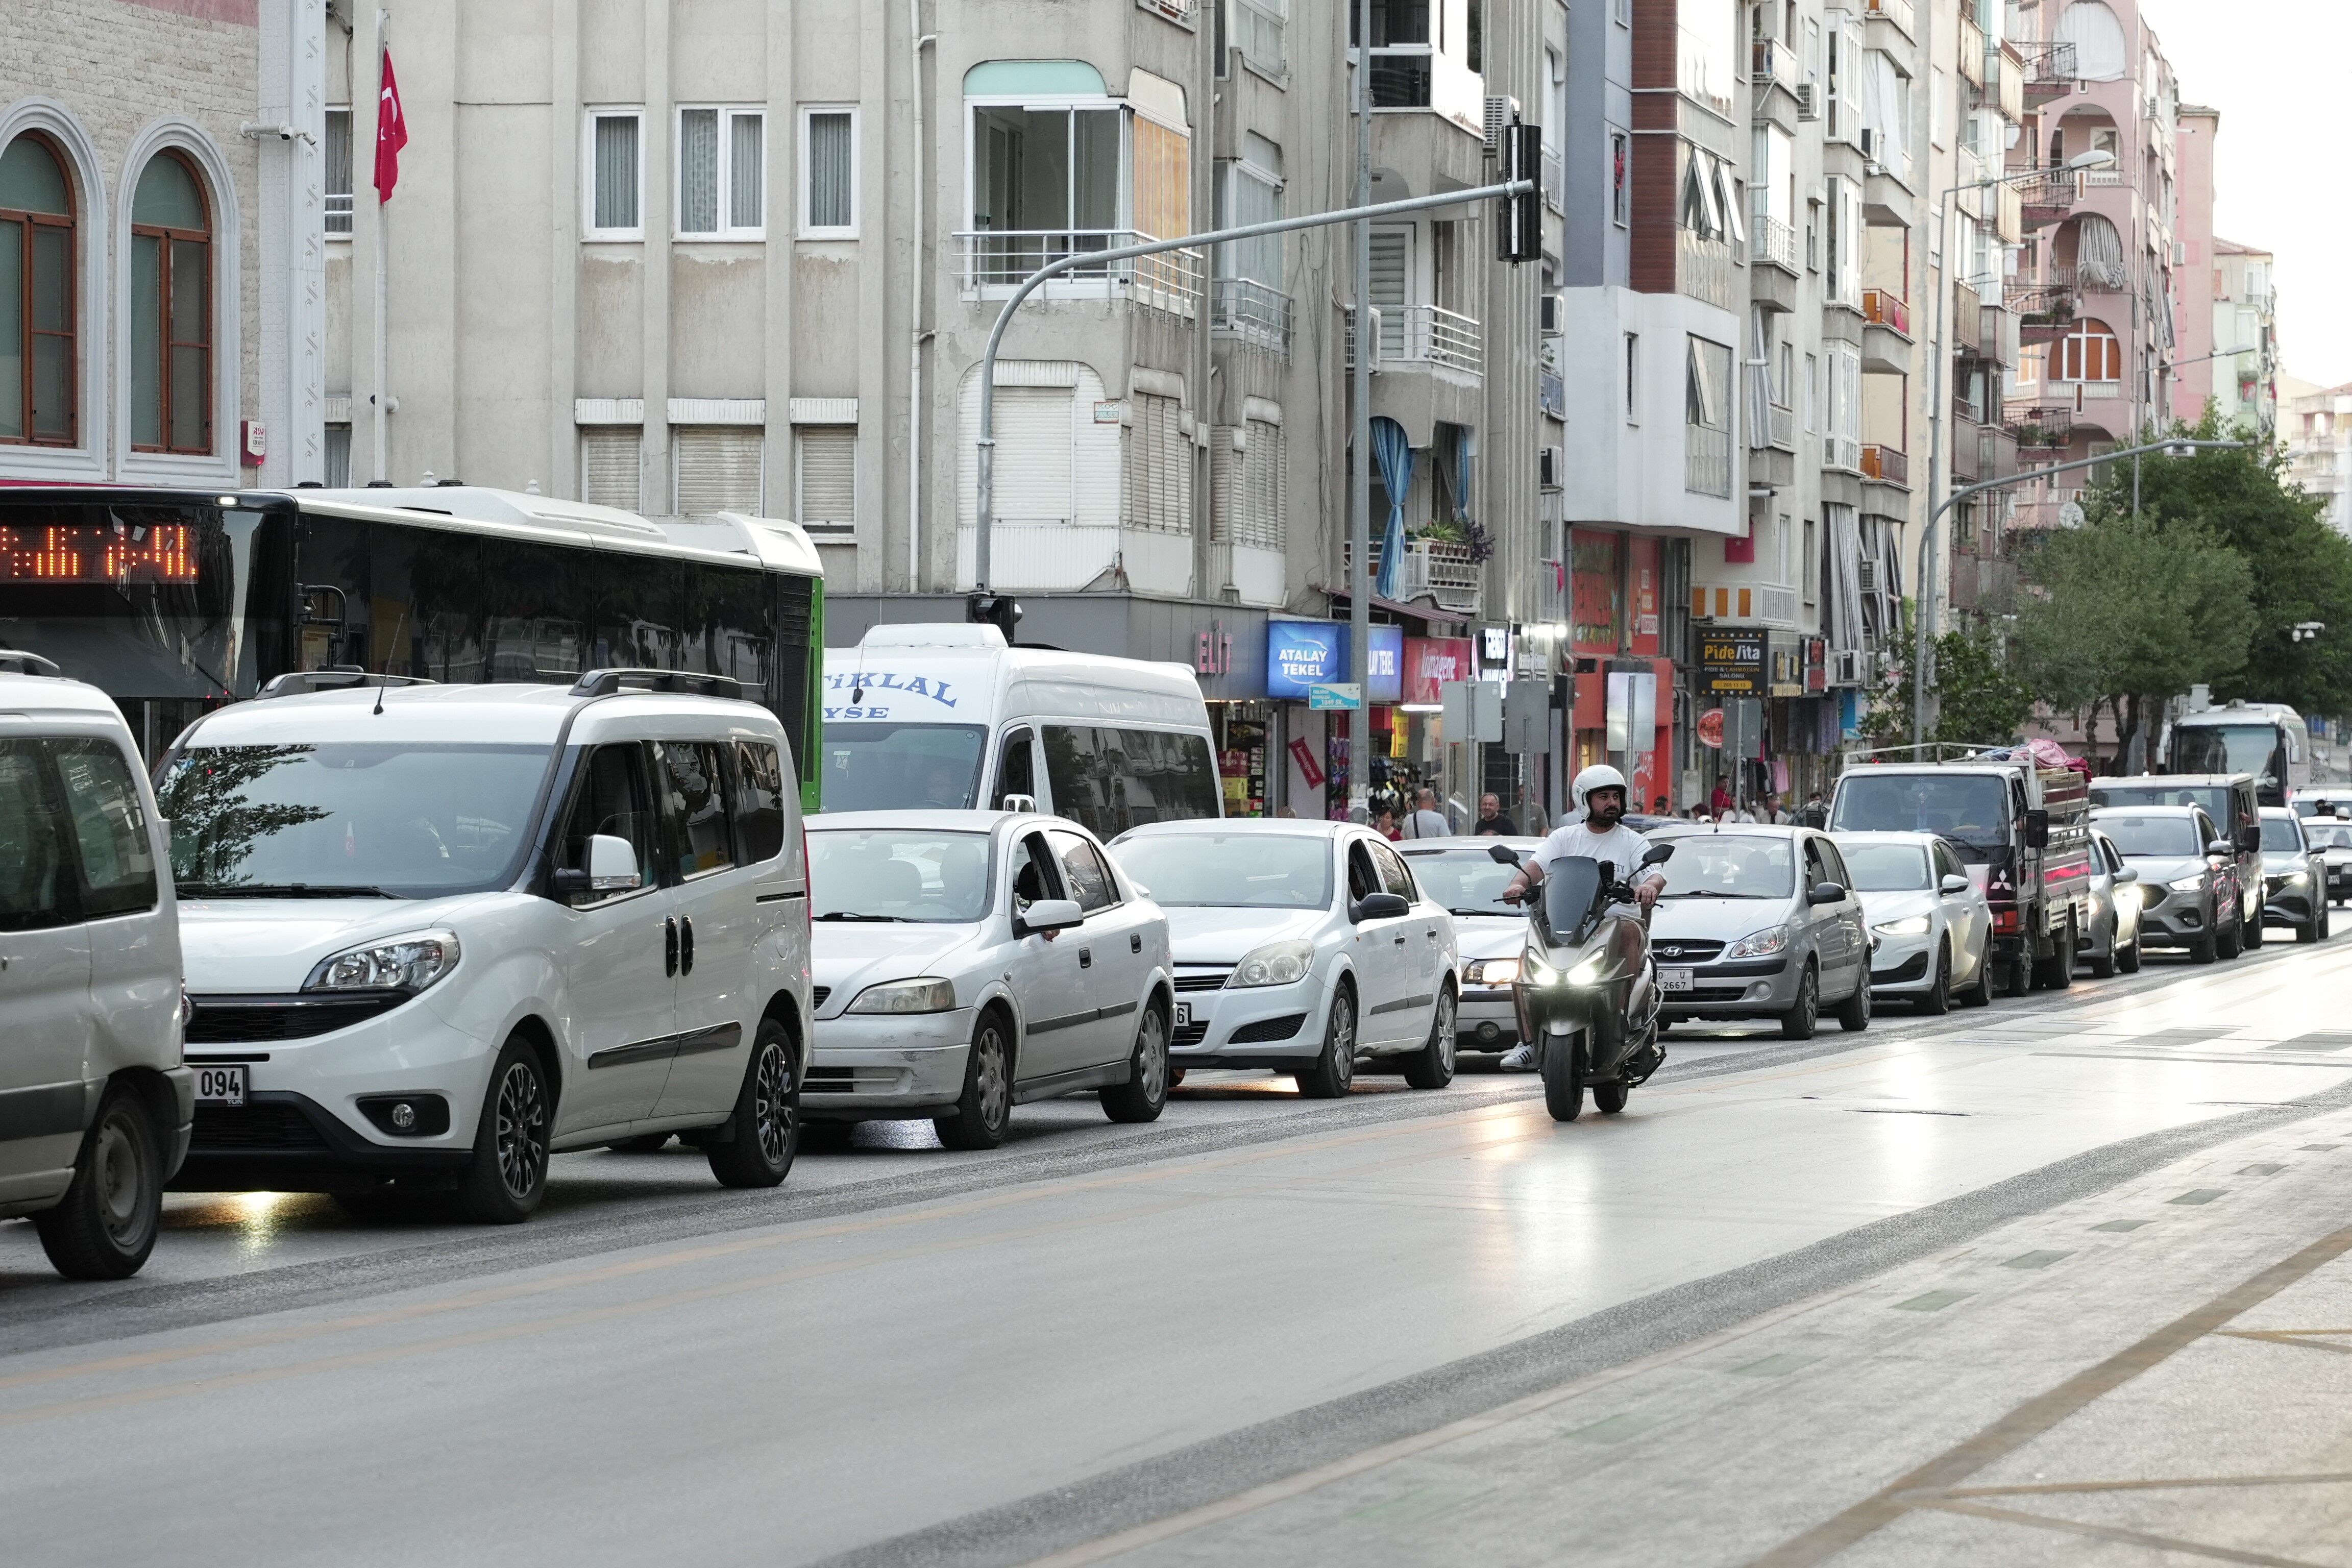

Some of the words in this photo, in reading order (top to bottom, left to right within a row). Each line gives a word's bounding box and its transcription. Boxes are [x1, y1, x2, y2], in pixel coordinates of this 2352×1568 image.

[1196, 619, 1233, 674] ELİT
[1279, 649, 1328, 662] ATALAY
[1282, 663, 1324, 676] TEKEL
[1368, 650, 1379, 675] LAY
[1379, 650, 1394, 675] TEKEL
[1420, 642, 1456, 691] komagene
[824, 707, 889, 719] YSE
[1177, 1008, 1185, 1023] 6
[202, 1071, 240, 1096] 094
